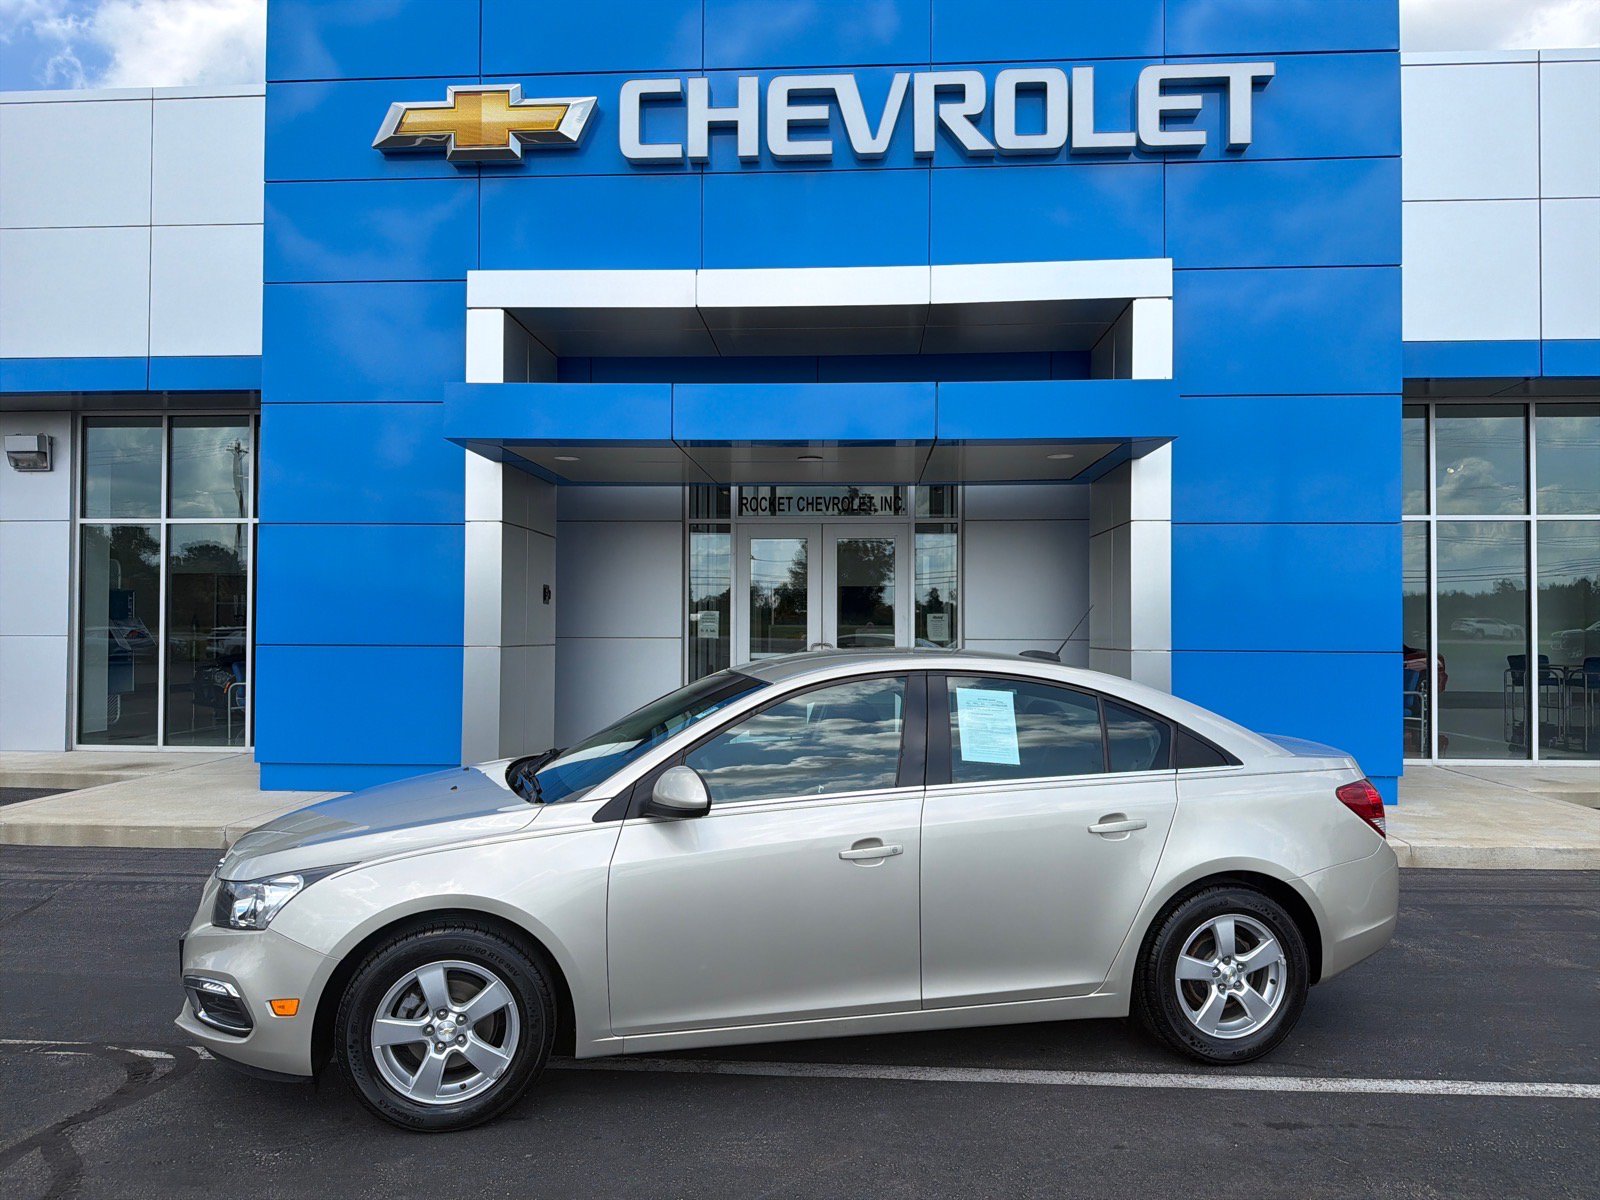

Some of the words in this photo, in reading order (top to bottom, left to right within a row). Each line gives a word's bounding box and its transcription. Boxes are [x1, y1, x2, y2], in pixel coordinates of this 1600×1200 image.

[619, 62, 1277, 164] CHEVROLET
[740, 496, 794, 513] ROCKET
[880, 496, 905, 513] INC.
